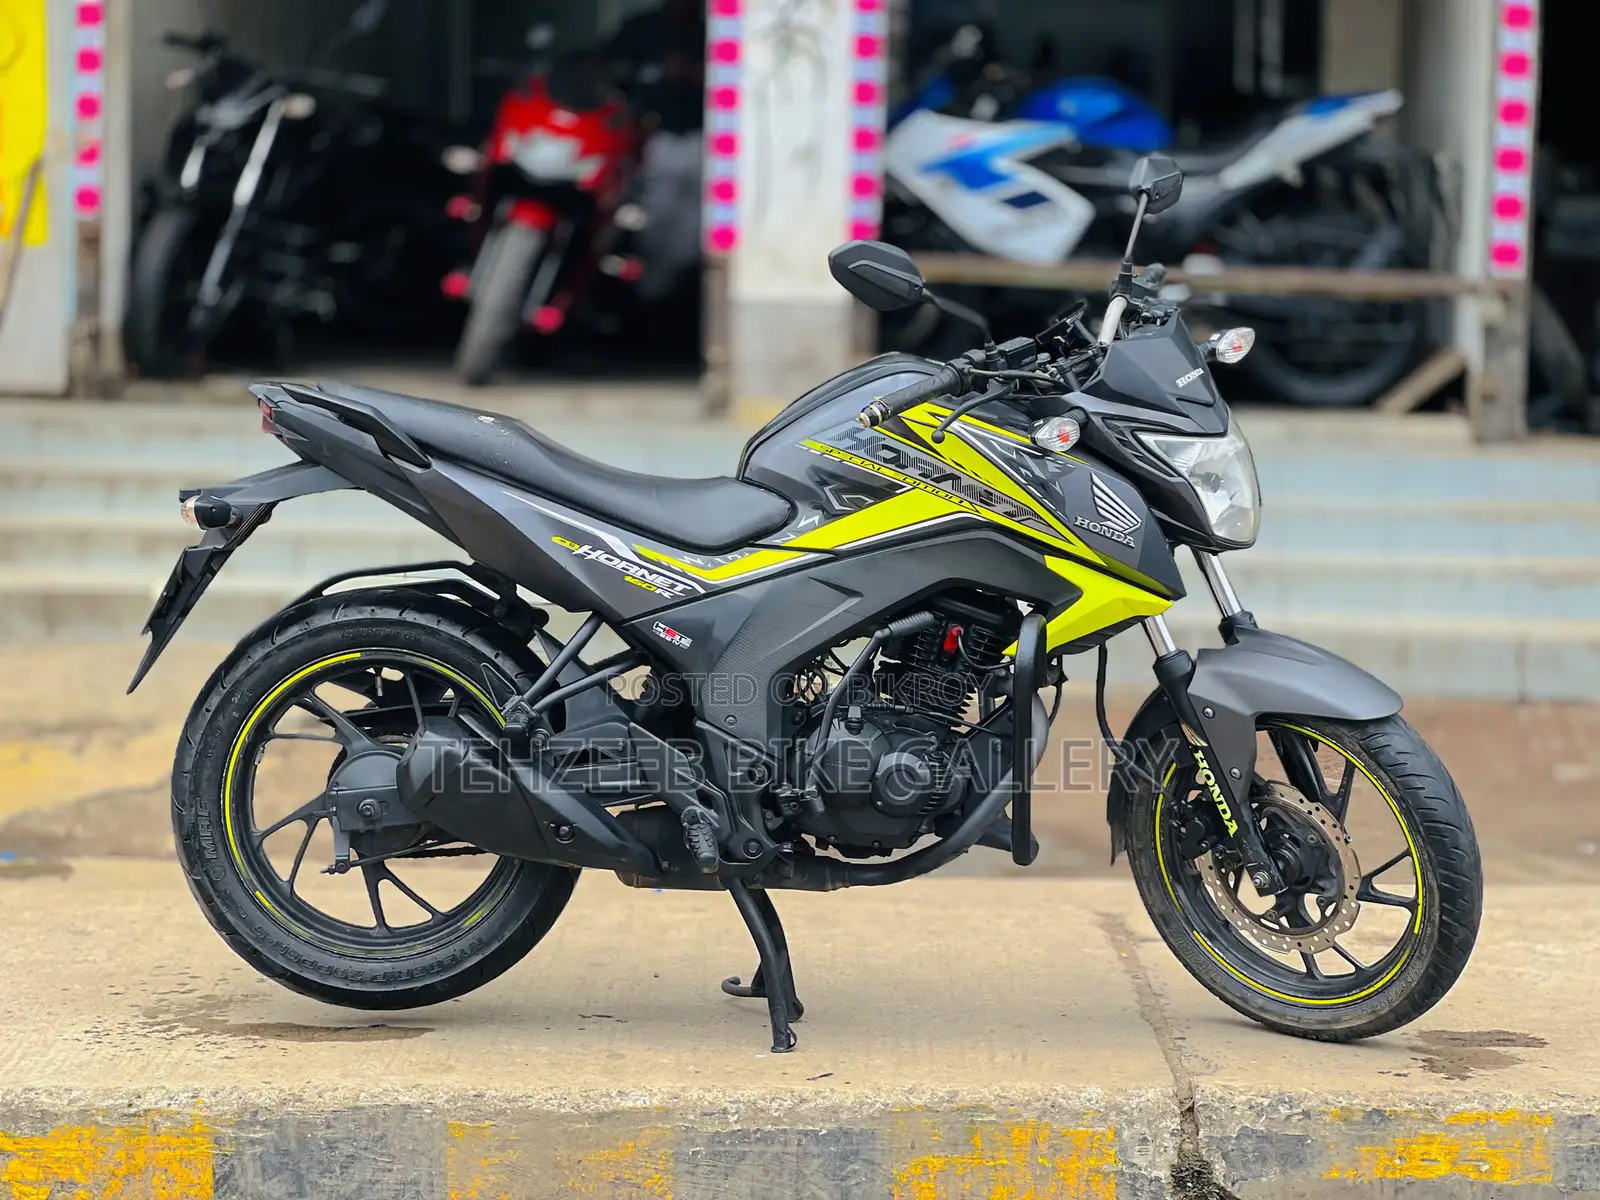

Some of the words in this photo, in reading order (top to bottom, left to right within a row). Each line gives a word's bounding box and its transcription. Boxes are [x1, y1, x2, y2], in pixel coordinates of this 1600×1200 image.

[818, 445, 882, 472] SPECIAL
[892, 472, 966, 505] EDITION
[1074, 515, 1136, 549] HONDA
[572, 544, 693, 593] HORNET
[623, 575, 675, 600] 160R
[1193, 749, 1239, 838] HONDA
